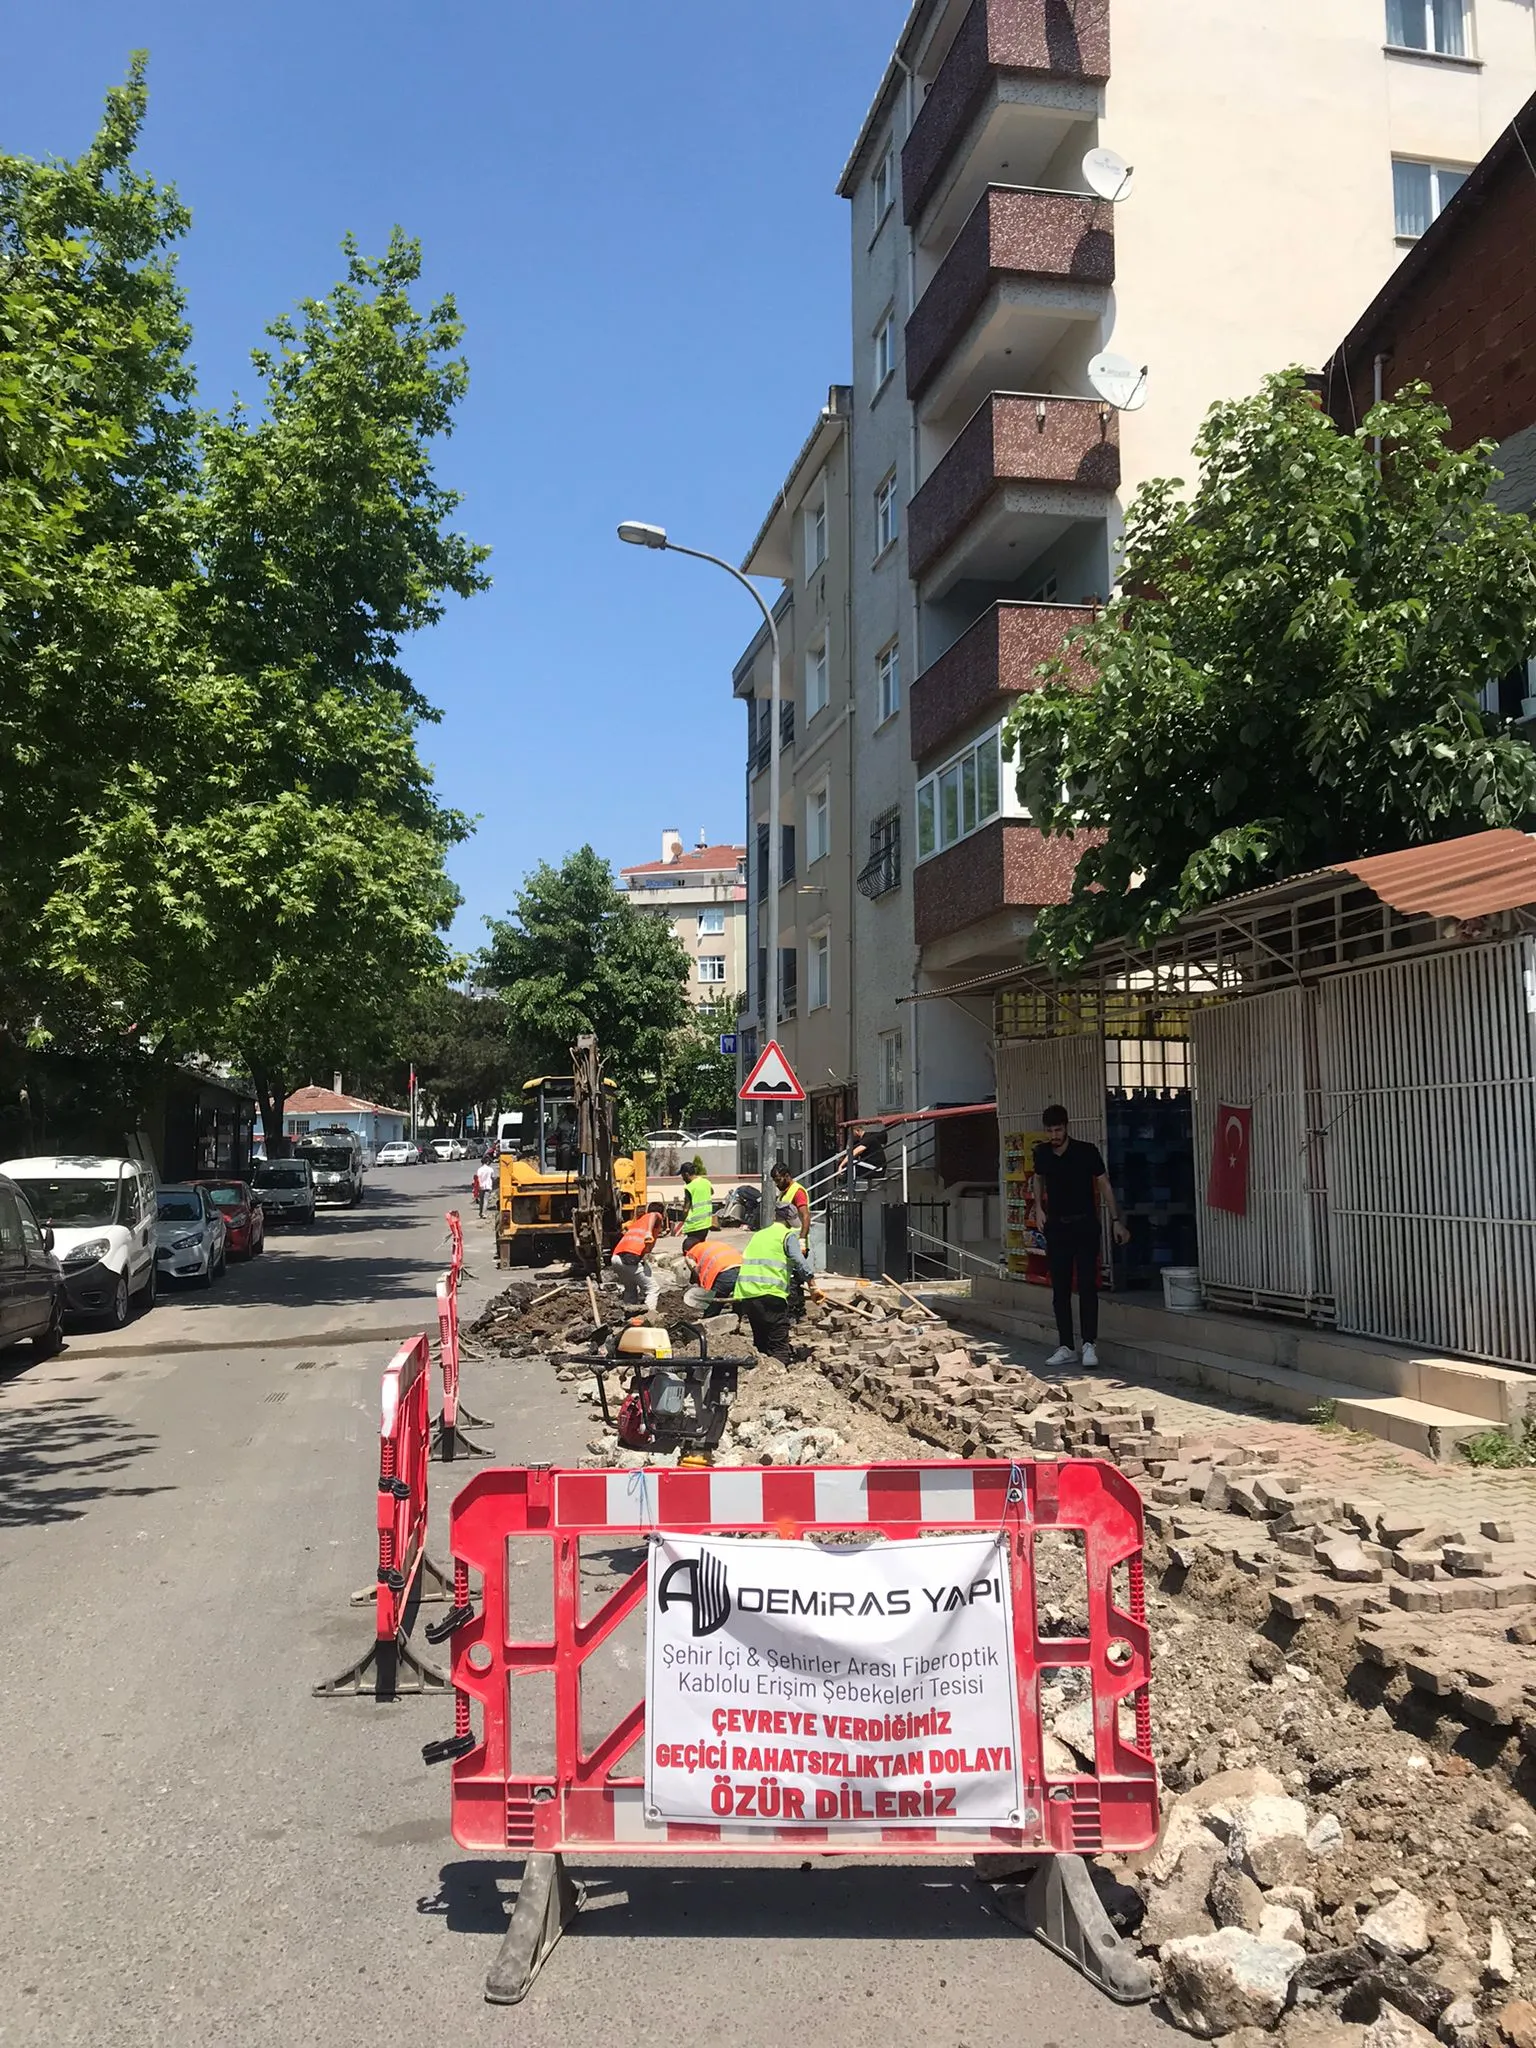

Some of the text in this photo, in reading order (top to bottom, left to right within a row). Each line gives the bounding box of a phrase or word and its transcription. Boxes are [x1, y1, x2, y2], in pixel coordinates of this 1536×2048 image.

[922, 1578, 1001, 1613] YAPI
[663, 1641, 999, 1677] Şehir İçi & Şehirler Arası Fiberoptik
[679, 1671, 983, 1704] Kablolu Erişim Şebekeleri Tesisi
[711, 1706, 952, 1742] ÇEVREYE VERDİĞİMİZ
[656, 1738, 1013, 1779] GEÇİCİ RAHATSIZLIKTAN DOLAYI
[710, 1774, 957, 1820] ÖZÜR DİLERİZ
